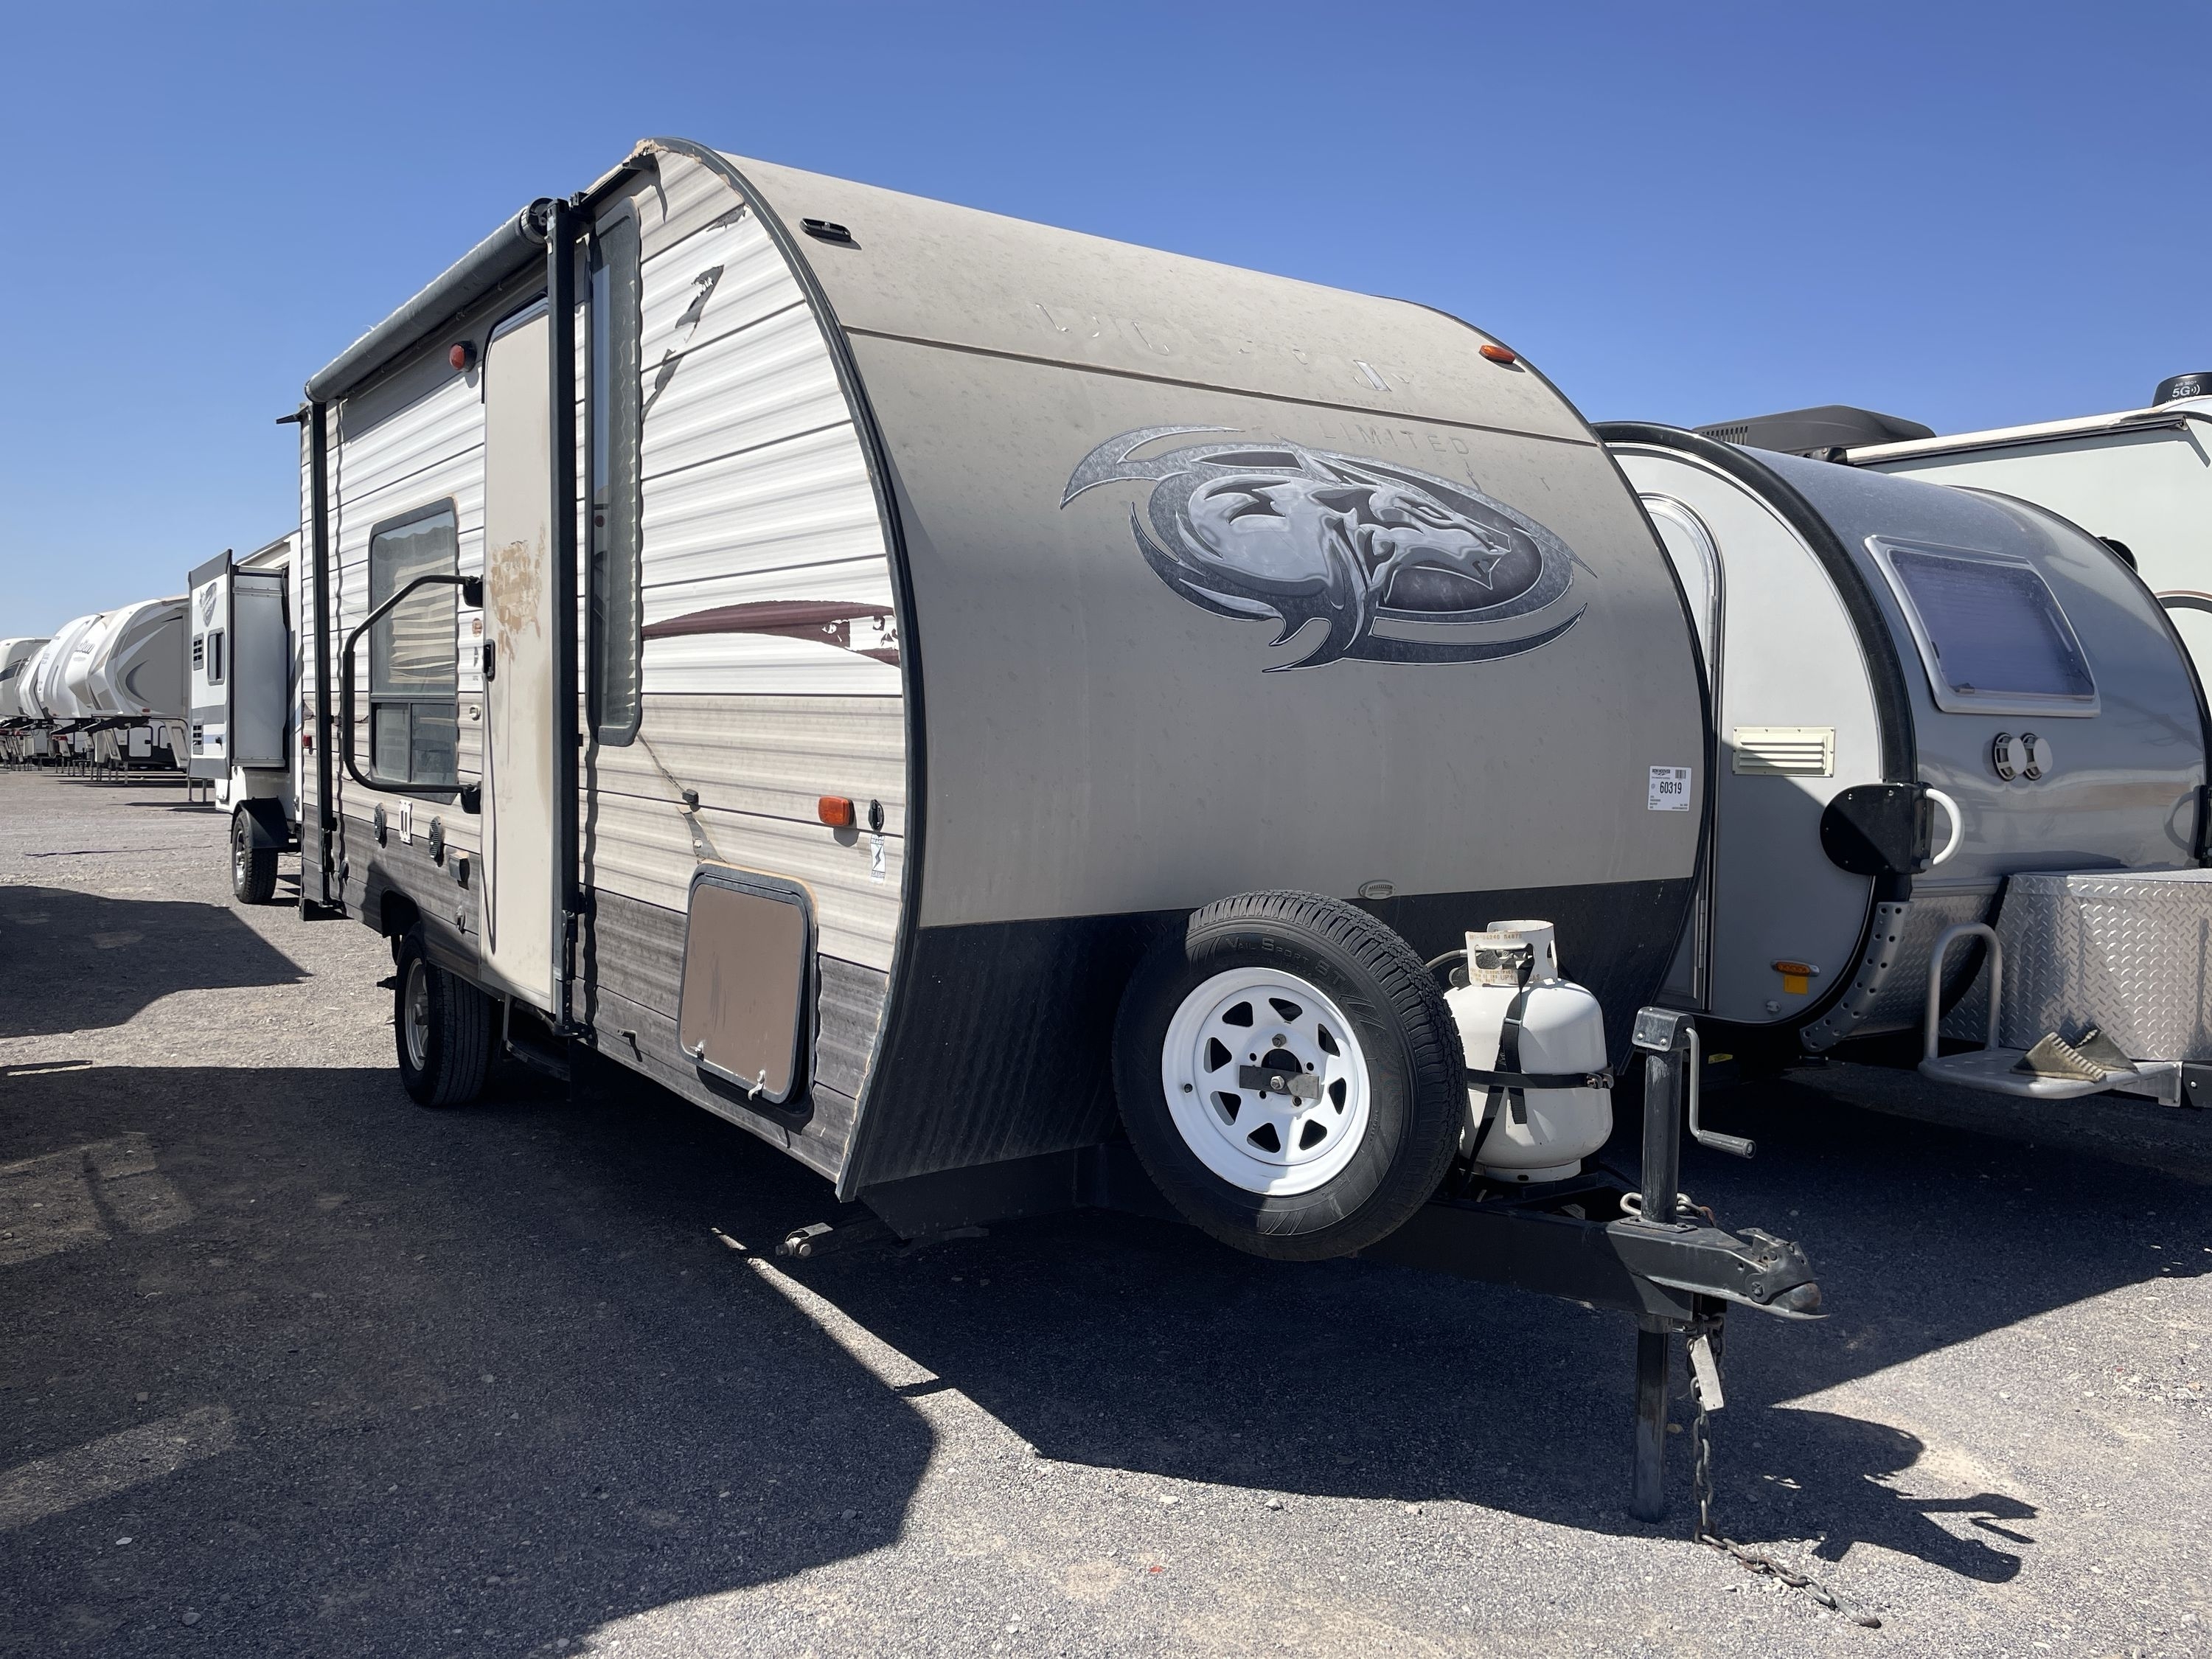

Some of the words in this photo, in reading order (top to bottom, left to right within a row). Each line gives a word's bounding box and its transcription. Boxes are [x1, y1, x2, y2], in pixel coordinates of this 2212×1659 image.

[2172, 386, 2190, 397] 5G
[1317, 422, 1470, 456] LIMITED
[1660, 782, 1682, 794] 60319
[1225, 936, 1256, 951] VAIL
[1262, 938, 1310, 964] SPORT
[1314, 959, 1347, 986] ST
